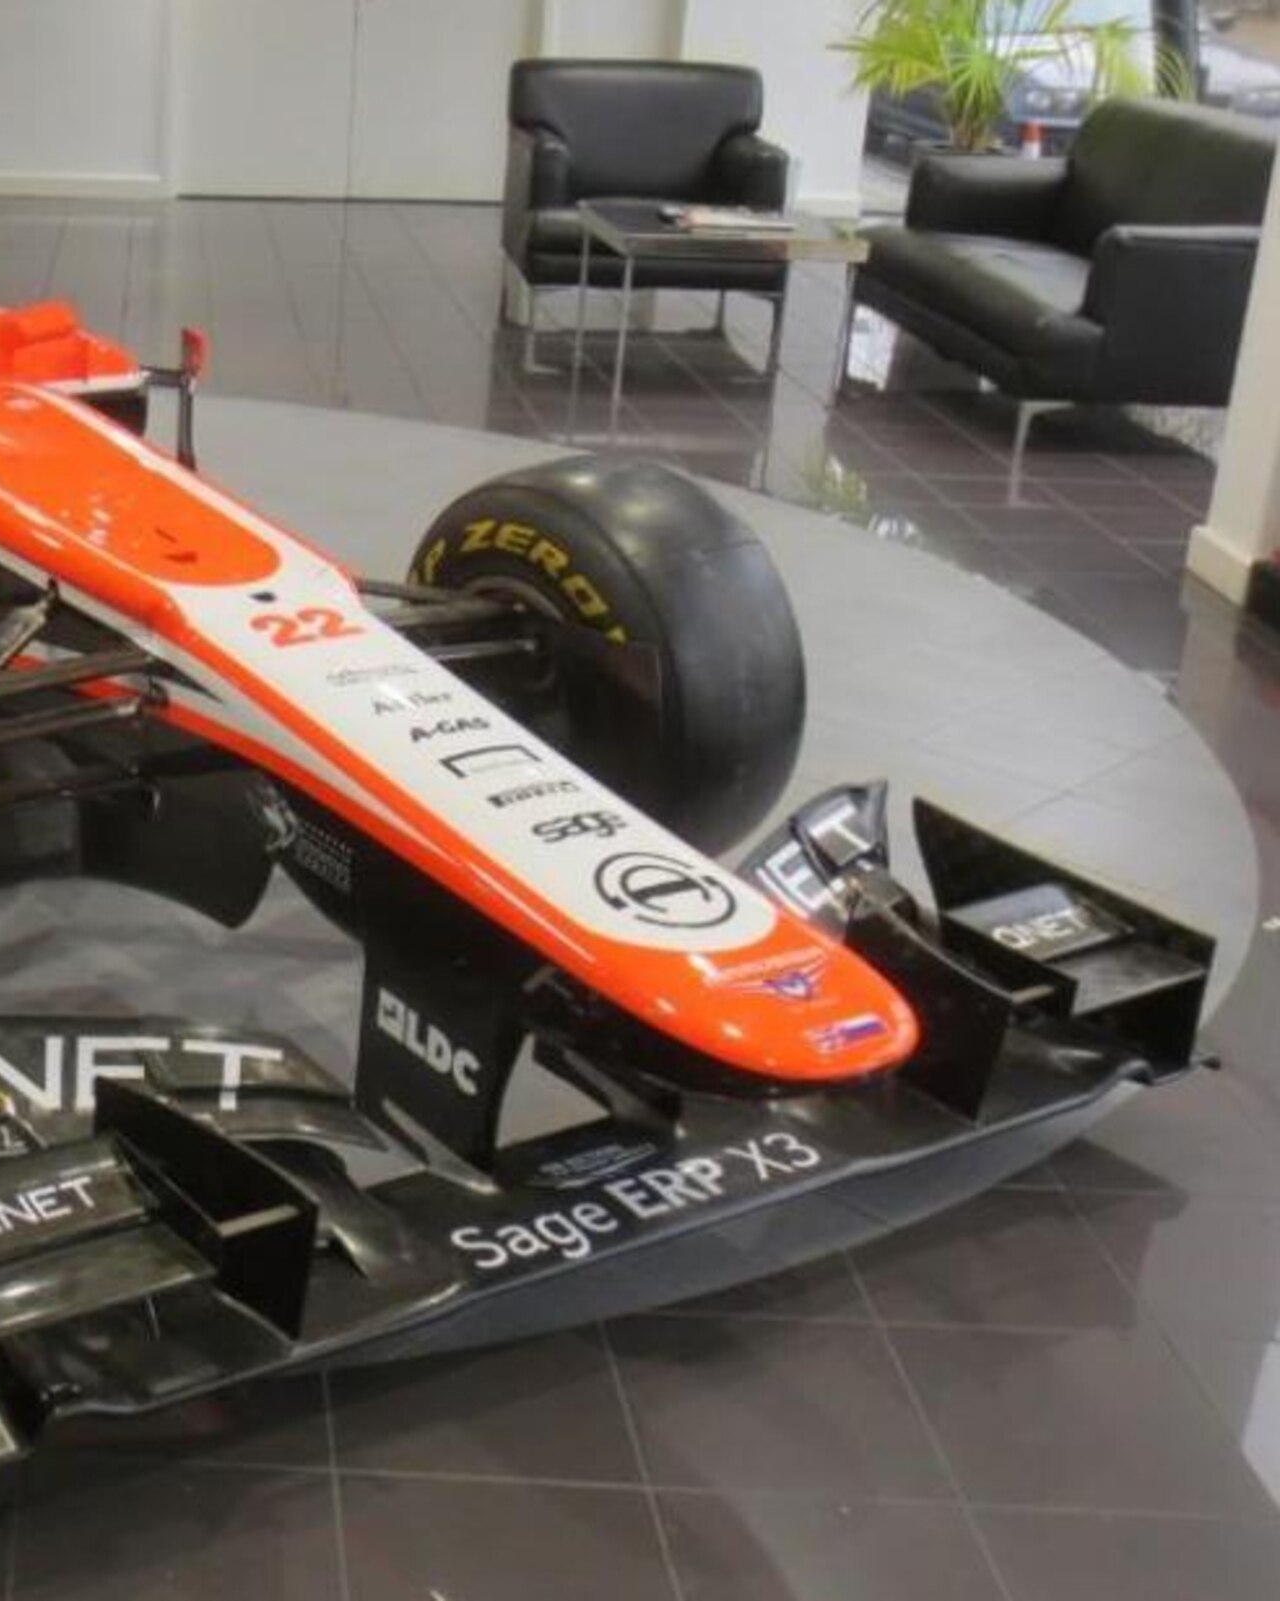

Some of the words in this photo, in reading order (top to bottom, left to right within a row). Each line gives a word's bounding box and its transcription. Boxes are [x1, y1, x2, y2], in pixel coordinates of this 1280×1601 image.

[460, 519, 610, 620] ZERO
[249, 606, 366, 648] 22
[991, 908, 1088, 950] QNET
[406, 1008, 480, 1096] LDC
[451, 1202, 618, 1269] Sage
[604, 1155, 724, 1220] ERP
[726, 1132, 819, 1181] X3
